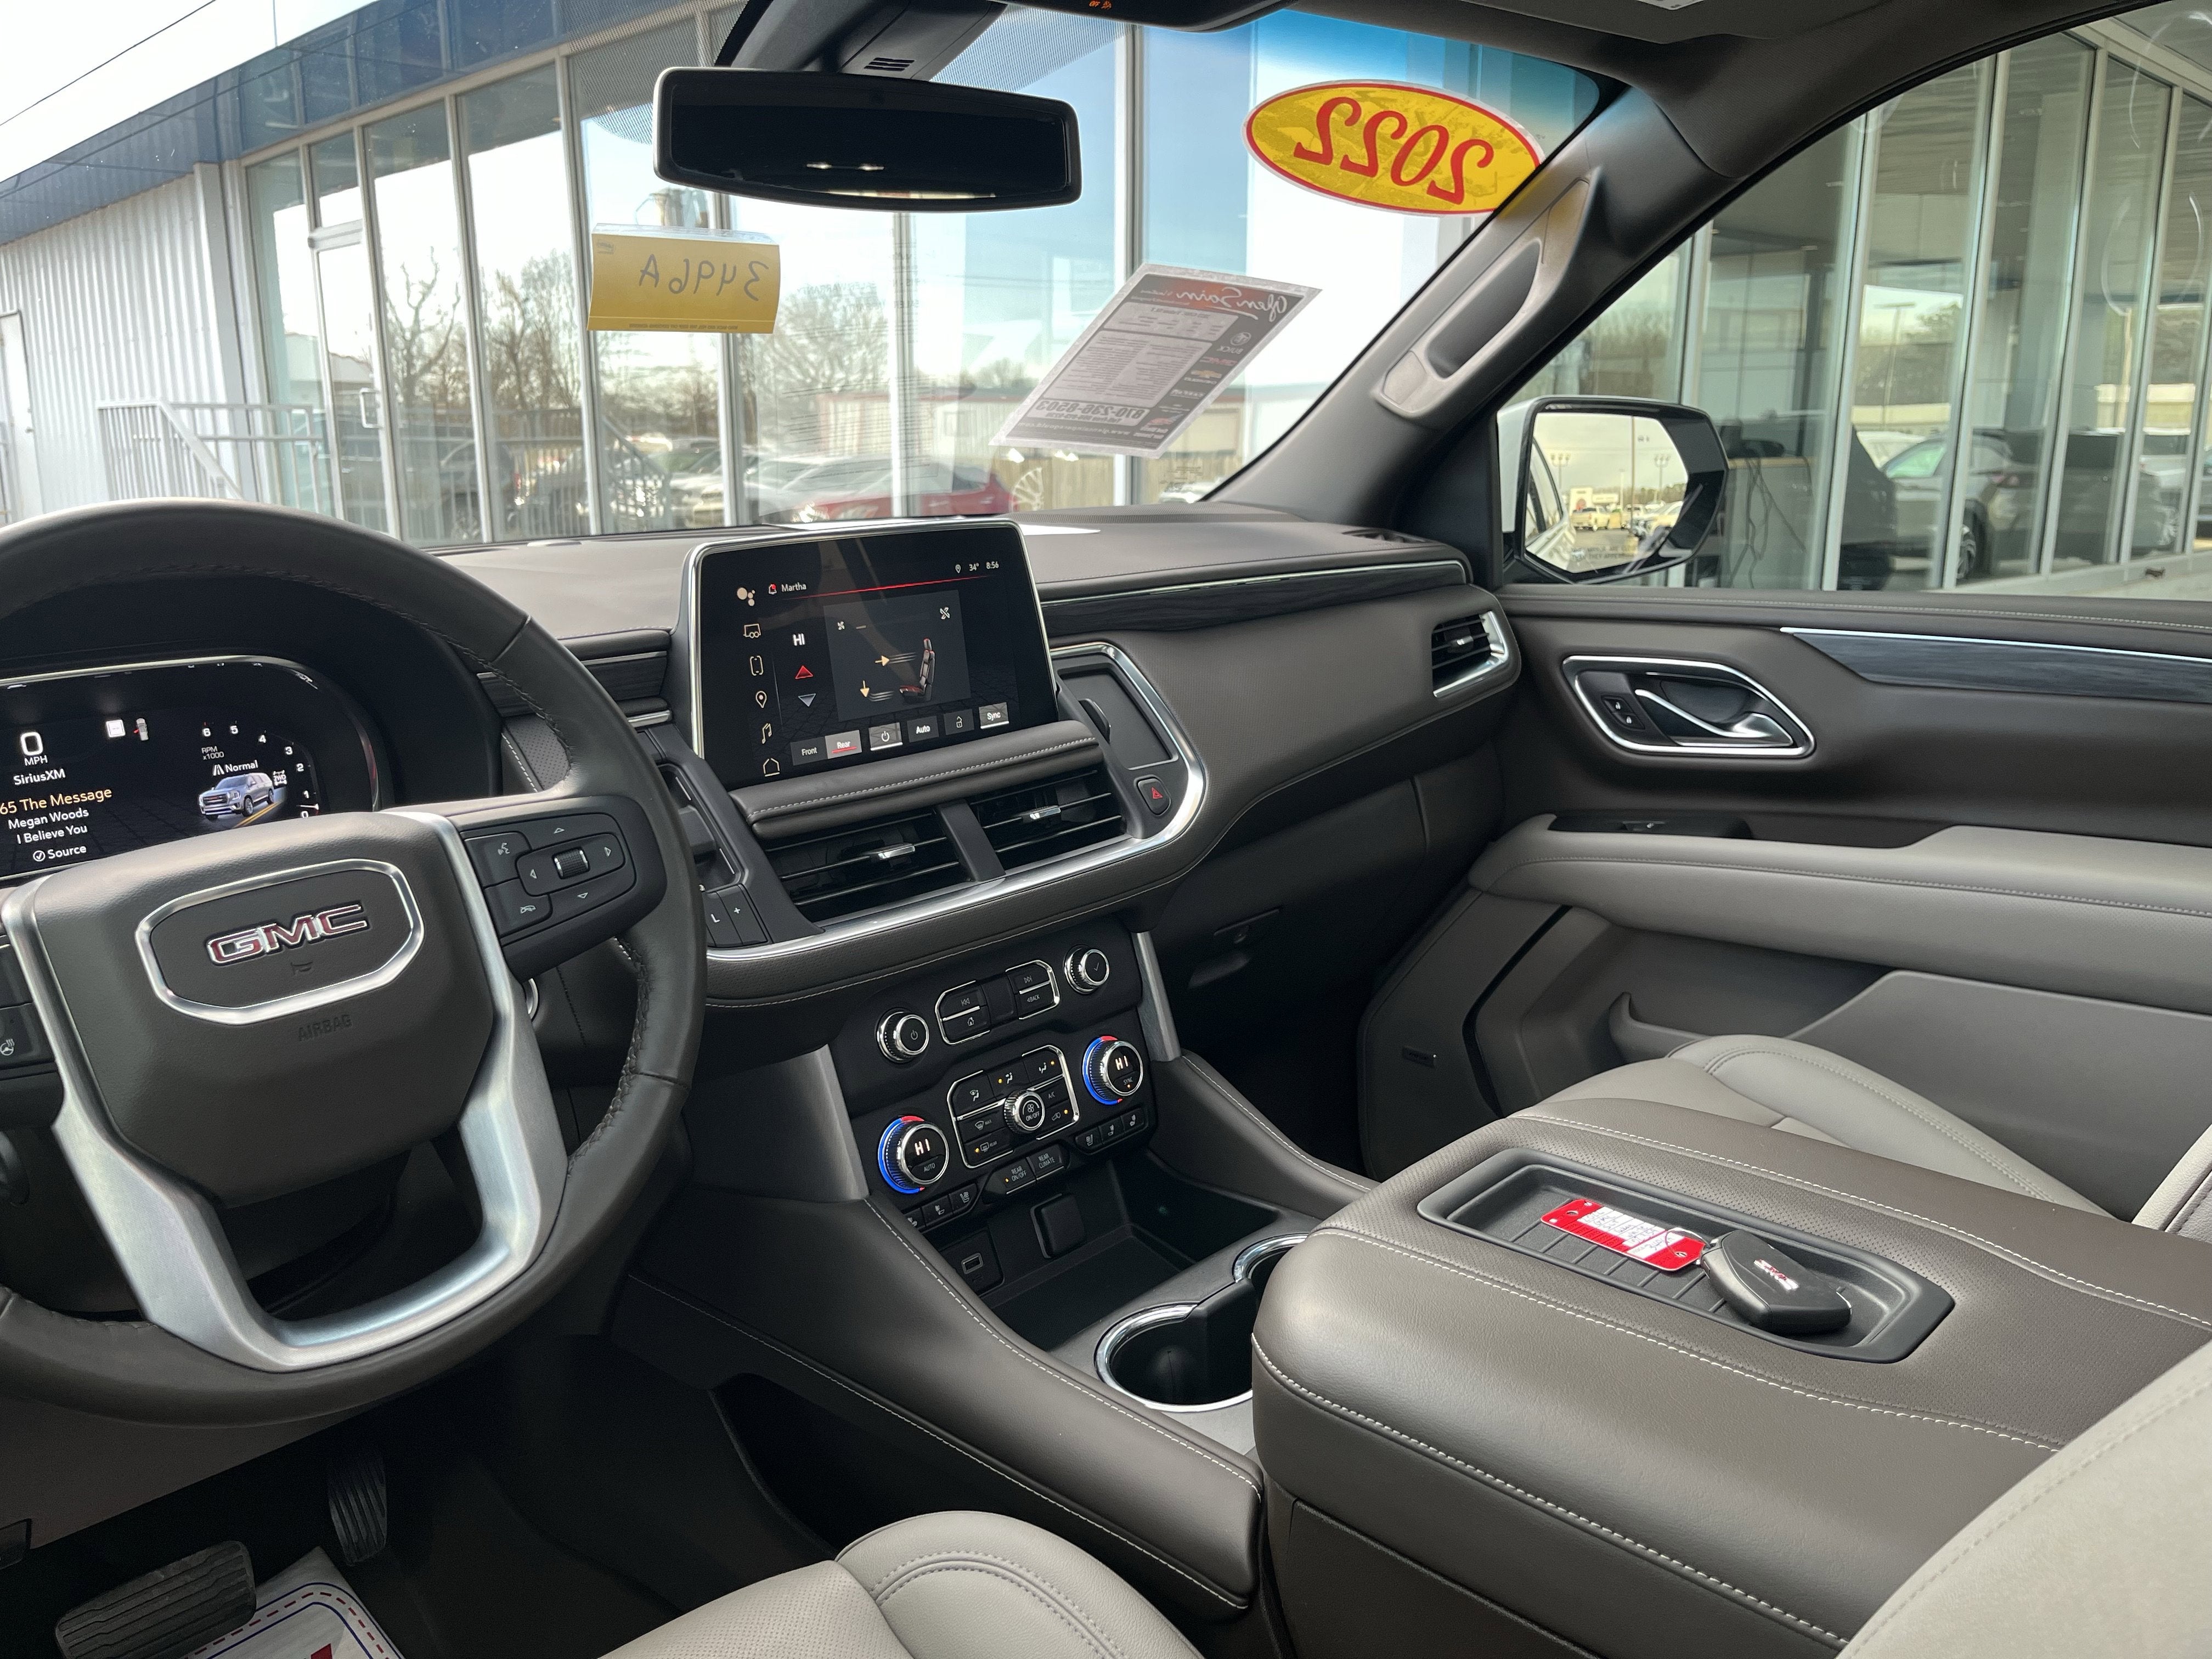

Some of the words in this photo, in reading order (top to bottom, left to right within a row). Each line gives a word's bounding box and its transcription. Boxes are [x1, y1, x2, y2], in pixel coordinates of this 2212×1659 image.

[986, 561, 999, 570] 8:56
[781, 582, 807, 592] Martha
[792, 633, 805, 646] HI
[987, 710, 1001, 721] Sync
[202, 728, 211, 737] 6
[230, 725, 239, 734] 5
[916, 724, 930, 734] Auto
[20, 731, 43, 756] 0
[258, 735, 267, 743] 4
[201, 746, 218, 754] RPM
[284, 746, 293, 755] 3
[801, 745, 817, 756] Front
[837, 740, 851, 750] Rear
[24, 755, 48, 766] MPH
[203, 751, 224, 760] x1000
[225, 759, 258, 773] Normal
[296, 763, 304, 772] 2
[13, 769, 66, 786] SiriusXM
[19, 797, 47, 811] The
[49, 789, 112, 807] Message
[303, 790, 309, 799] 1
[8, 816, 48, 830] Megan
[49, 807, 89, 822] Woods
[16, 834, 21, 844] I
[23, 830, 65, 844] Believe
[65, 825, 88, 836] You
[47, 845, 87, 859] Source
[207, 902, 368, 964] GMC
[1029, 994, 1040, 1002] BACK
[298, 1014, 353, 1041] AIRBAG
[1115, 1056, 1128, 1071] HI
[1123, 1076, 1134, 1086] SYNC
[1025, 1111, 1040, 1122] ON/OFF
[915, 1138, 930, 1156] HI
[1038, 1153, 1049, 1162] REAR
[1039, 1156, 1056, 1169] CLIMATE
[923, 1162, 935, 1172] AUTO
[1011, 1166, 1023, 1175] REAR
[1011, 1170, 1028, 1182] ON/OFF
